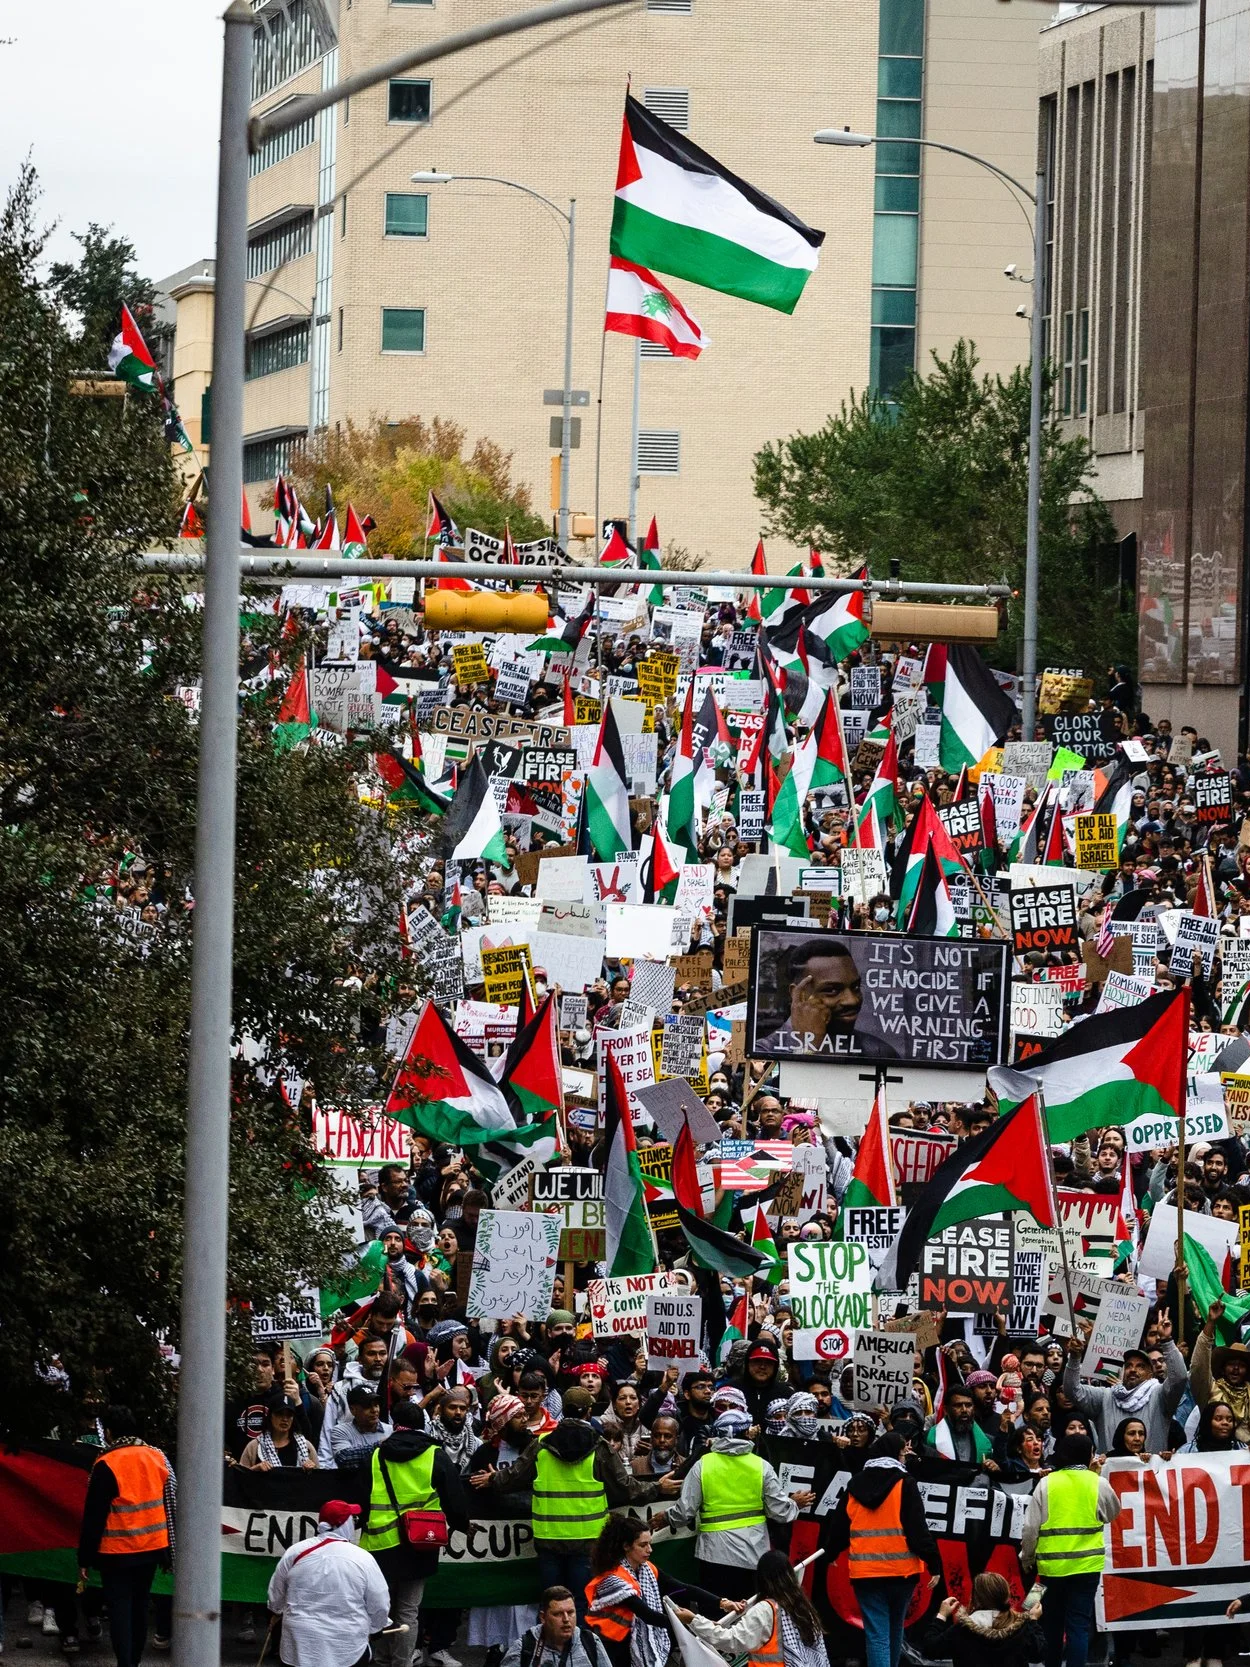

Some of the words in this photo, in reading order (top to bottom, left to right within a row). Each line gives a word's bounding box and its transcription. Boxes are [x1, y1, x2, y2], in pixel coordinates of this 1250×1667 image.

[470, 529, 499, 550] END
[732, 632, 756, 645] FREE
[313, 670, 350, 685] STOP
[852, 680, 866, 689] END
[852, 694, 876, 706] NOW
[1054, 715, 1102, 731] GLORY
[1053, 731, 1072, 742] TO
[1074, 730, 1102, 742] OUR
[526, 751, 574, 765] CEASE
[1195, 776, 1229, 791] CEASE
[741, 794, 761, 804] FREE
[1196, 788, 1230, 807] FIRE
[1077, 817, 1095, 829] END
[1098, 815, 1114, 828] ALL
[1100, 829, 1114, 839] AID
[683, 865, 707, 878] END
[1011, 890, 1072, 907] CEASE
[409, 909, 429, 929] TEXAS
[1013, 904, 1074, 930] FIRE
[1180, 917, 1201, 932] FREE
[1202, 921, 1218, 935] ALL
[727, 940, 749, 949] FREE
[1016, 927, 1076, 949] NOW.
[1144, 934, 1156, 944] SEA
[869, 942, 914, 965] IT'S
[934, 947, 979, 968] NOT
[866, 968, 959, 990] GENOCIDE
[977, 972, 994, 990] IF
[1050, 963, 1080, 980] FREE
[1108, 972, 1148, 997] BOMBING
[715, 985, 746, 1003] GAZA
[871, 992, 904, 1012] WE
[915, 993, 961, 1014] GIVE
[974, 997, 989, 1016] A
[1047, 1008, 1063, 1028] IS
[601, 1035, 633, 1050] FROM
[635, 1030, 650, 1046] THE
[774, 1031, 862, 1054] ISRAEL
[635, 1051, 647, 1063] TO
[912, 1039, 974, 1061] FIRST
[636, 1067, 653, 1081] SEA
[494, 1185, 506, 1201] WE
[506, 1160, 535, 1188] STAND
[534, 1174, 570, 1199] WE
[506, 1183, 530, 1205] WITH
[849, 1208, 900, 1236] FREE
[793, 1243, 867, 1283] STOP
[923, 1246, 1010, 1278] FIRE
[606, 1278, 621, 1295] It's
[626, 1274, 656, 1292] NOT
[816, 1281, 840, 1295] THE
[923, 1278, 1008, 1306] NOW.
[654, 1303, 674, 1316] END
[676, 1304, 695, 1316] U.S.
[791, 1291, 872, 1330] BLOCKADE
[658, 1322, 674, 1335] AID
[678, 1322, 690, 1335] TO
[649, 1338, 698, 1358] ISRAEL
[822, 1338, 844, 1352] STOP
[856, 1334, 915, 1353] AMERICA
[872, 1355, 886, 1367] IS
[856, 1365, 910, 1383] ISRAELS
[1108, 1467, 1219, 1569] END
[244, 1511, 319, 1555] END
